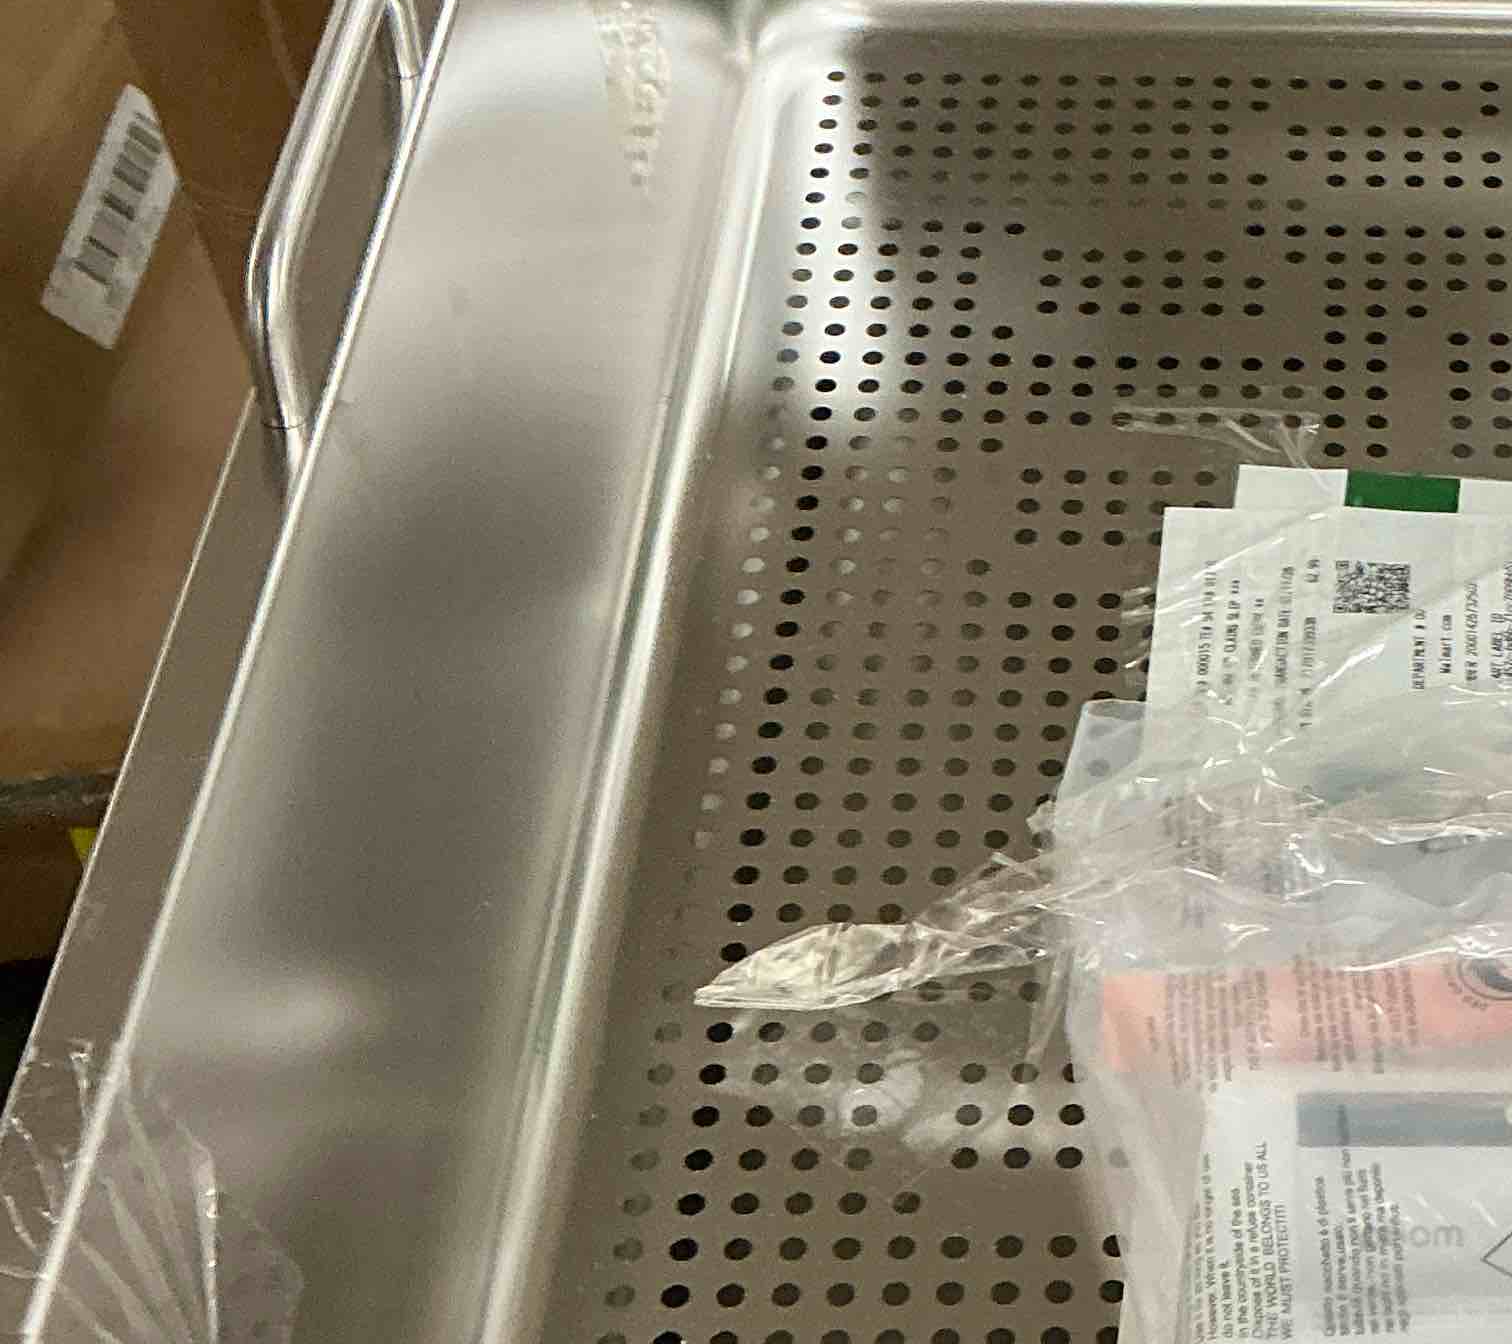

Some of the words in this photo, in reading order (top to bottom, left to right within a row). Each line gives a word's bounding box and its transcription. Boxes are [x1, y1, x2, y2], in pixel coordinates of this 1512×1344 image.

[1254, 1141, 1268, 1160] ALL
[1258, 1199, 1276, 1256] BELONGS
[1262, 1262, 1279, 1309] WORLD
[1276, 1275, 1293, 1315] MUST
[1263, 1311, 1280, 1339] THE
[1278, 1318, 1294, 1341] WE
